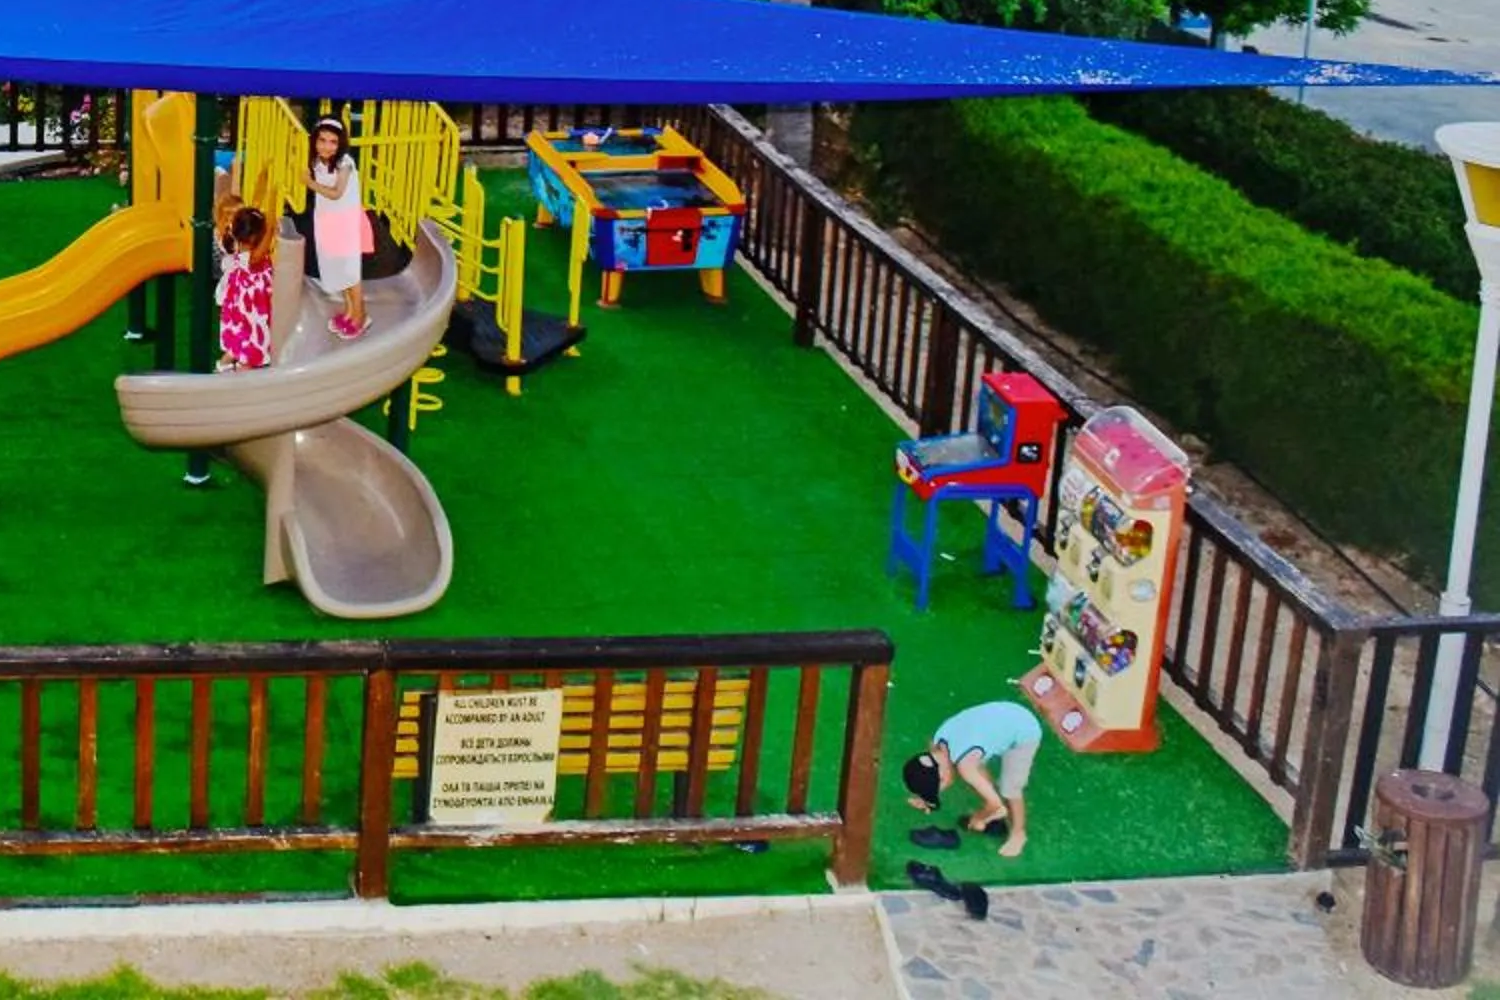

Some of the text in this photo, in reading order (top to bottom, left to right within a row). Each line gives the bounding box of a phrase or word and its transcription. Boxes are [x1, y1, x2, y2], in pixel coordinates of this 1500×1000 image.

[468, 698, 505, 709] CHILDREN
[507, 697, 527, 707] MUST
[530, 697, 538, 706] BE
[445, 712, 545, 725] ACCOMPANIED BY AN ADULT
